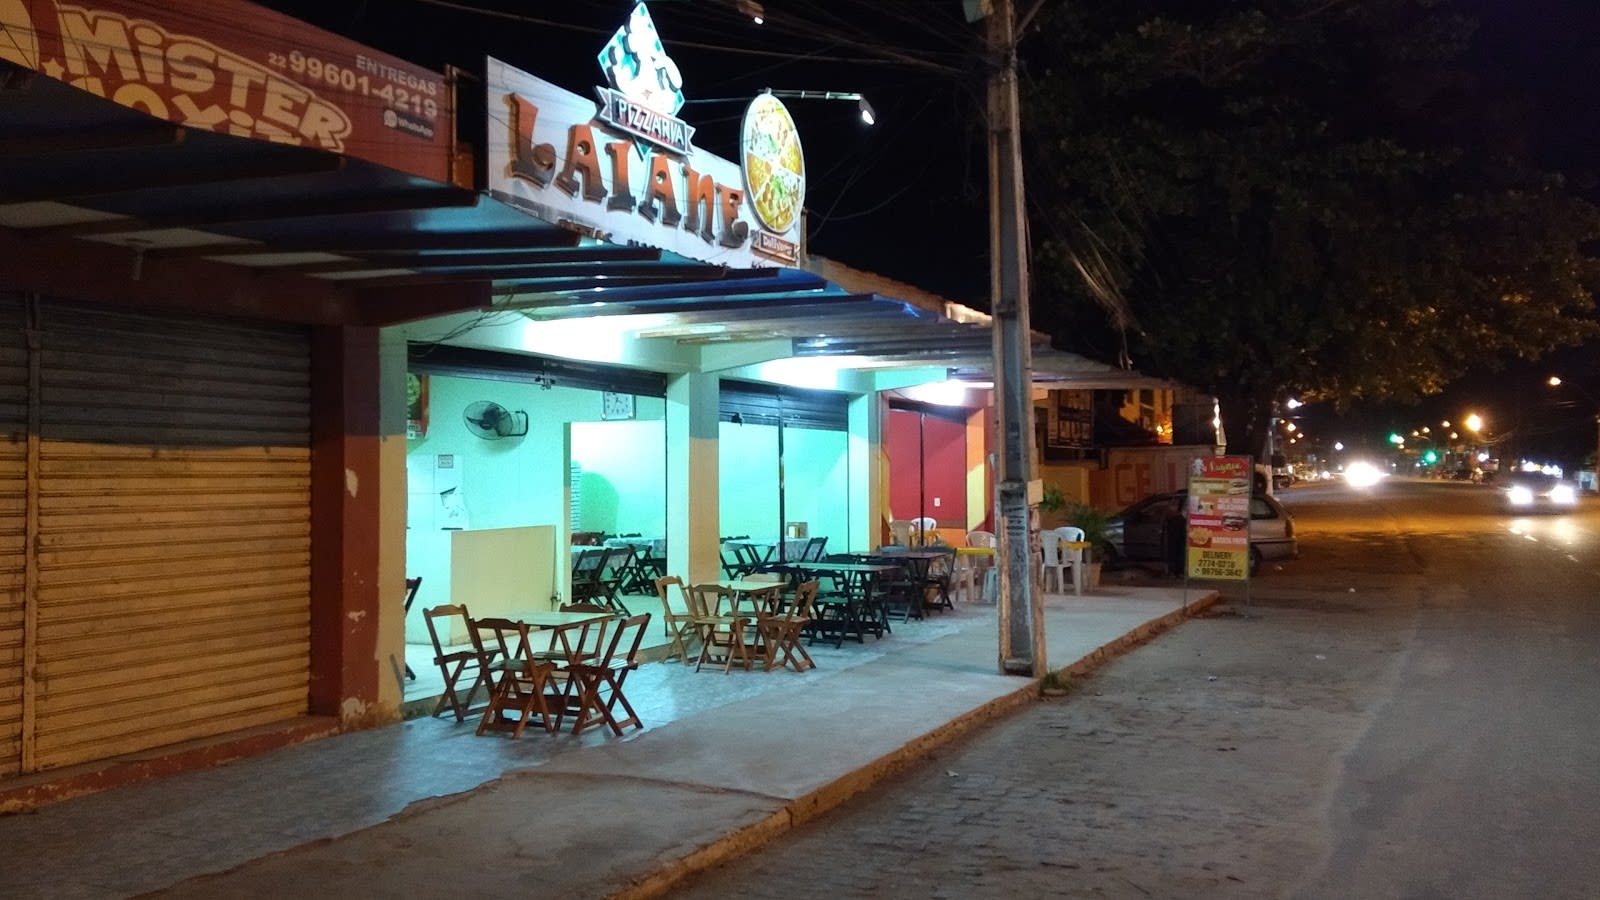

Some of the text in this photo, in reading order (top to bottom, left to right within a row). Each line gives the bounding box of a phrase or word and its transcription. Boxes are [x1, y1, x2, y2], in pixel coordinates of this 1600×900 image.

[268, 52, 287, 68] 22
[289, 50, 438, 118] 99601-4219
[356, 54, 437, 96] ENTREGAS
[1202, 550, 1233, 560] DELIVERY
